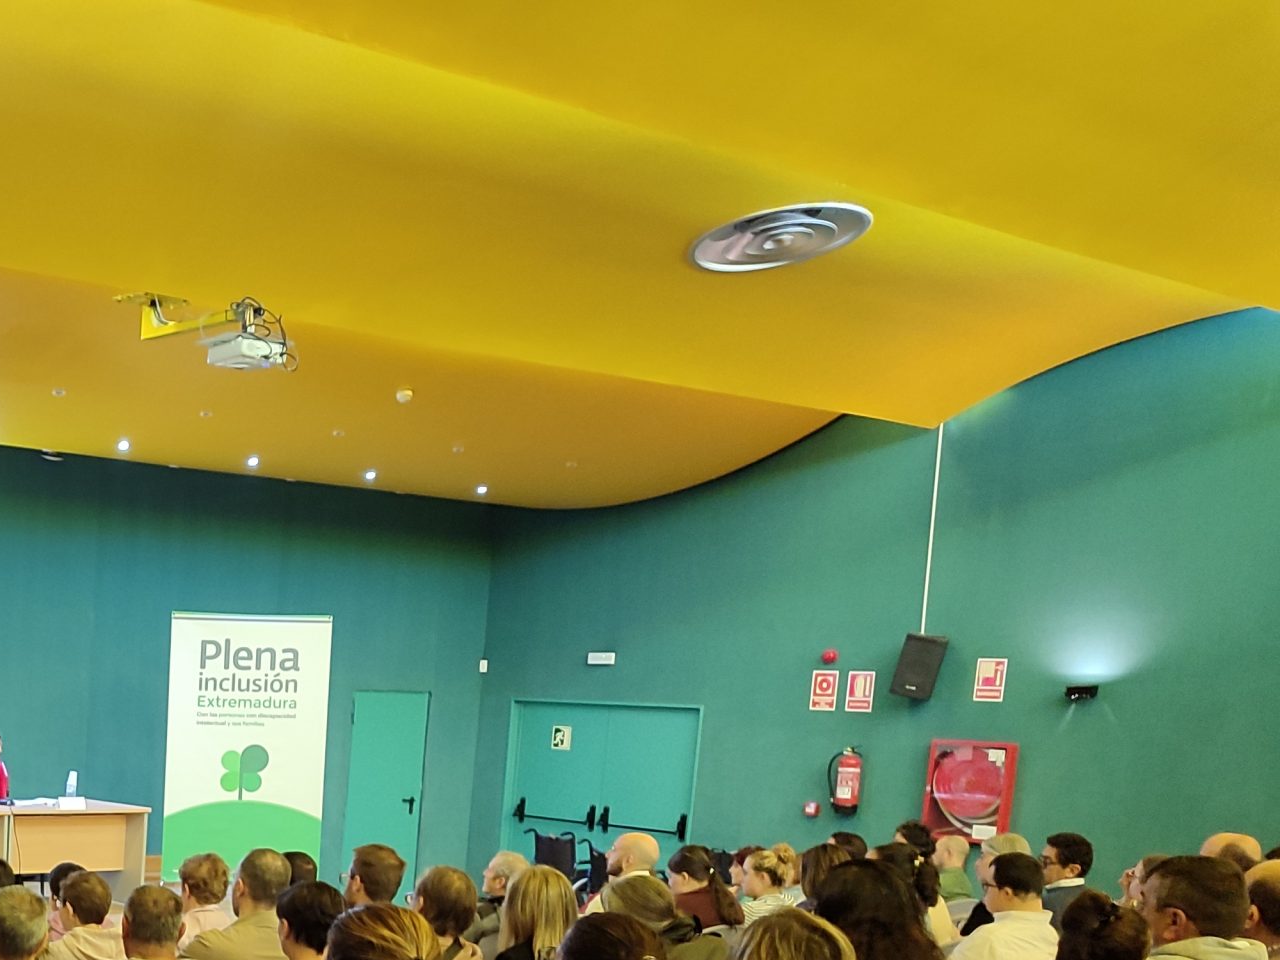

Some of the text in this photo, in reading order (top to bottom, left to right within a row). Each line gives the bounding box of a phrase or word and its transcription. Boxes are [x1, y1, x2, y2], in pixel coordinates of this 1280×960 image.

[199, 638, 300, 671] Plena
[198, 671, 298, 693] inclusión
[196, 695, 297, 709] Extremadura
